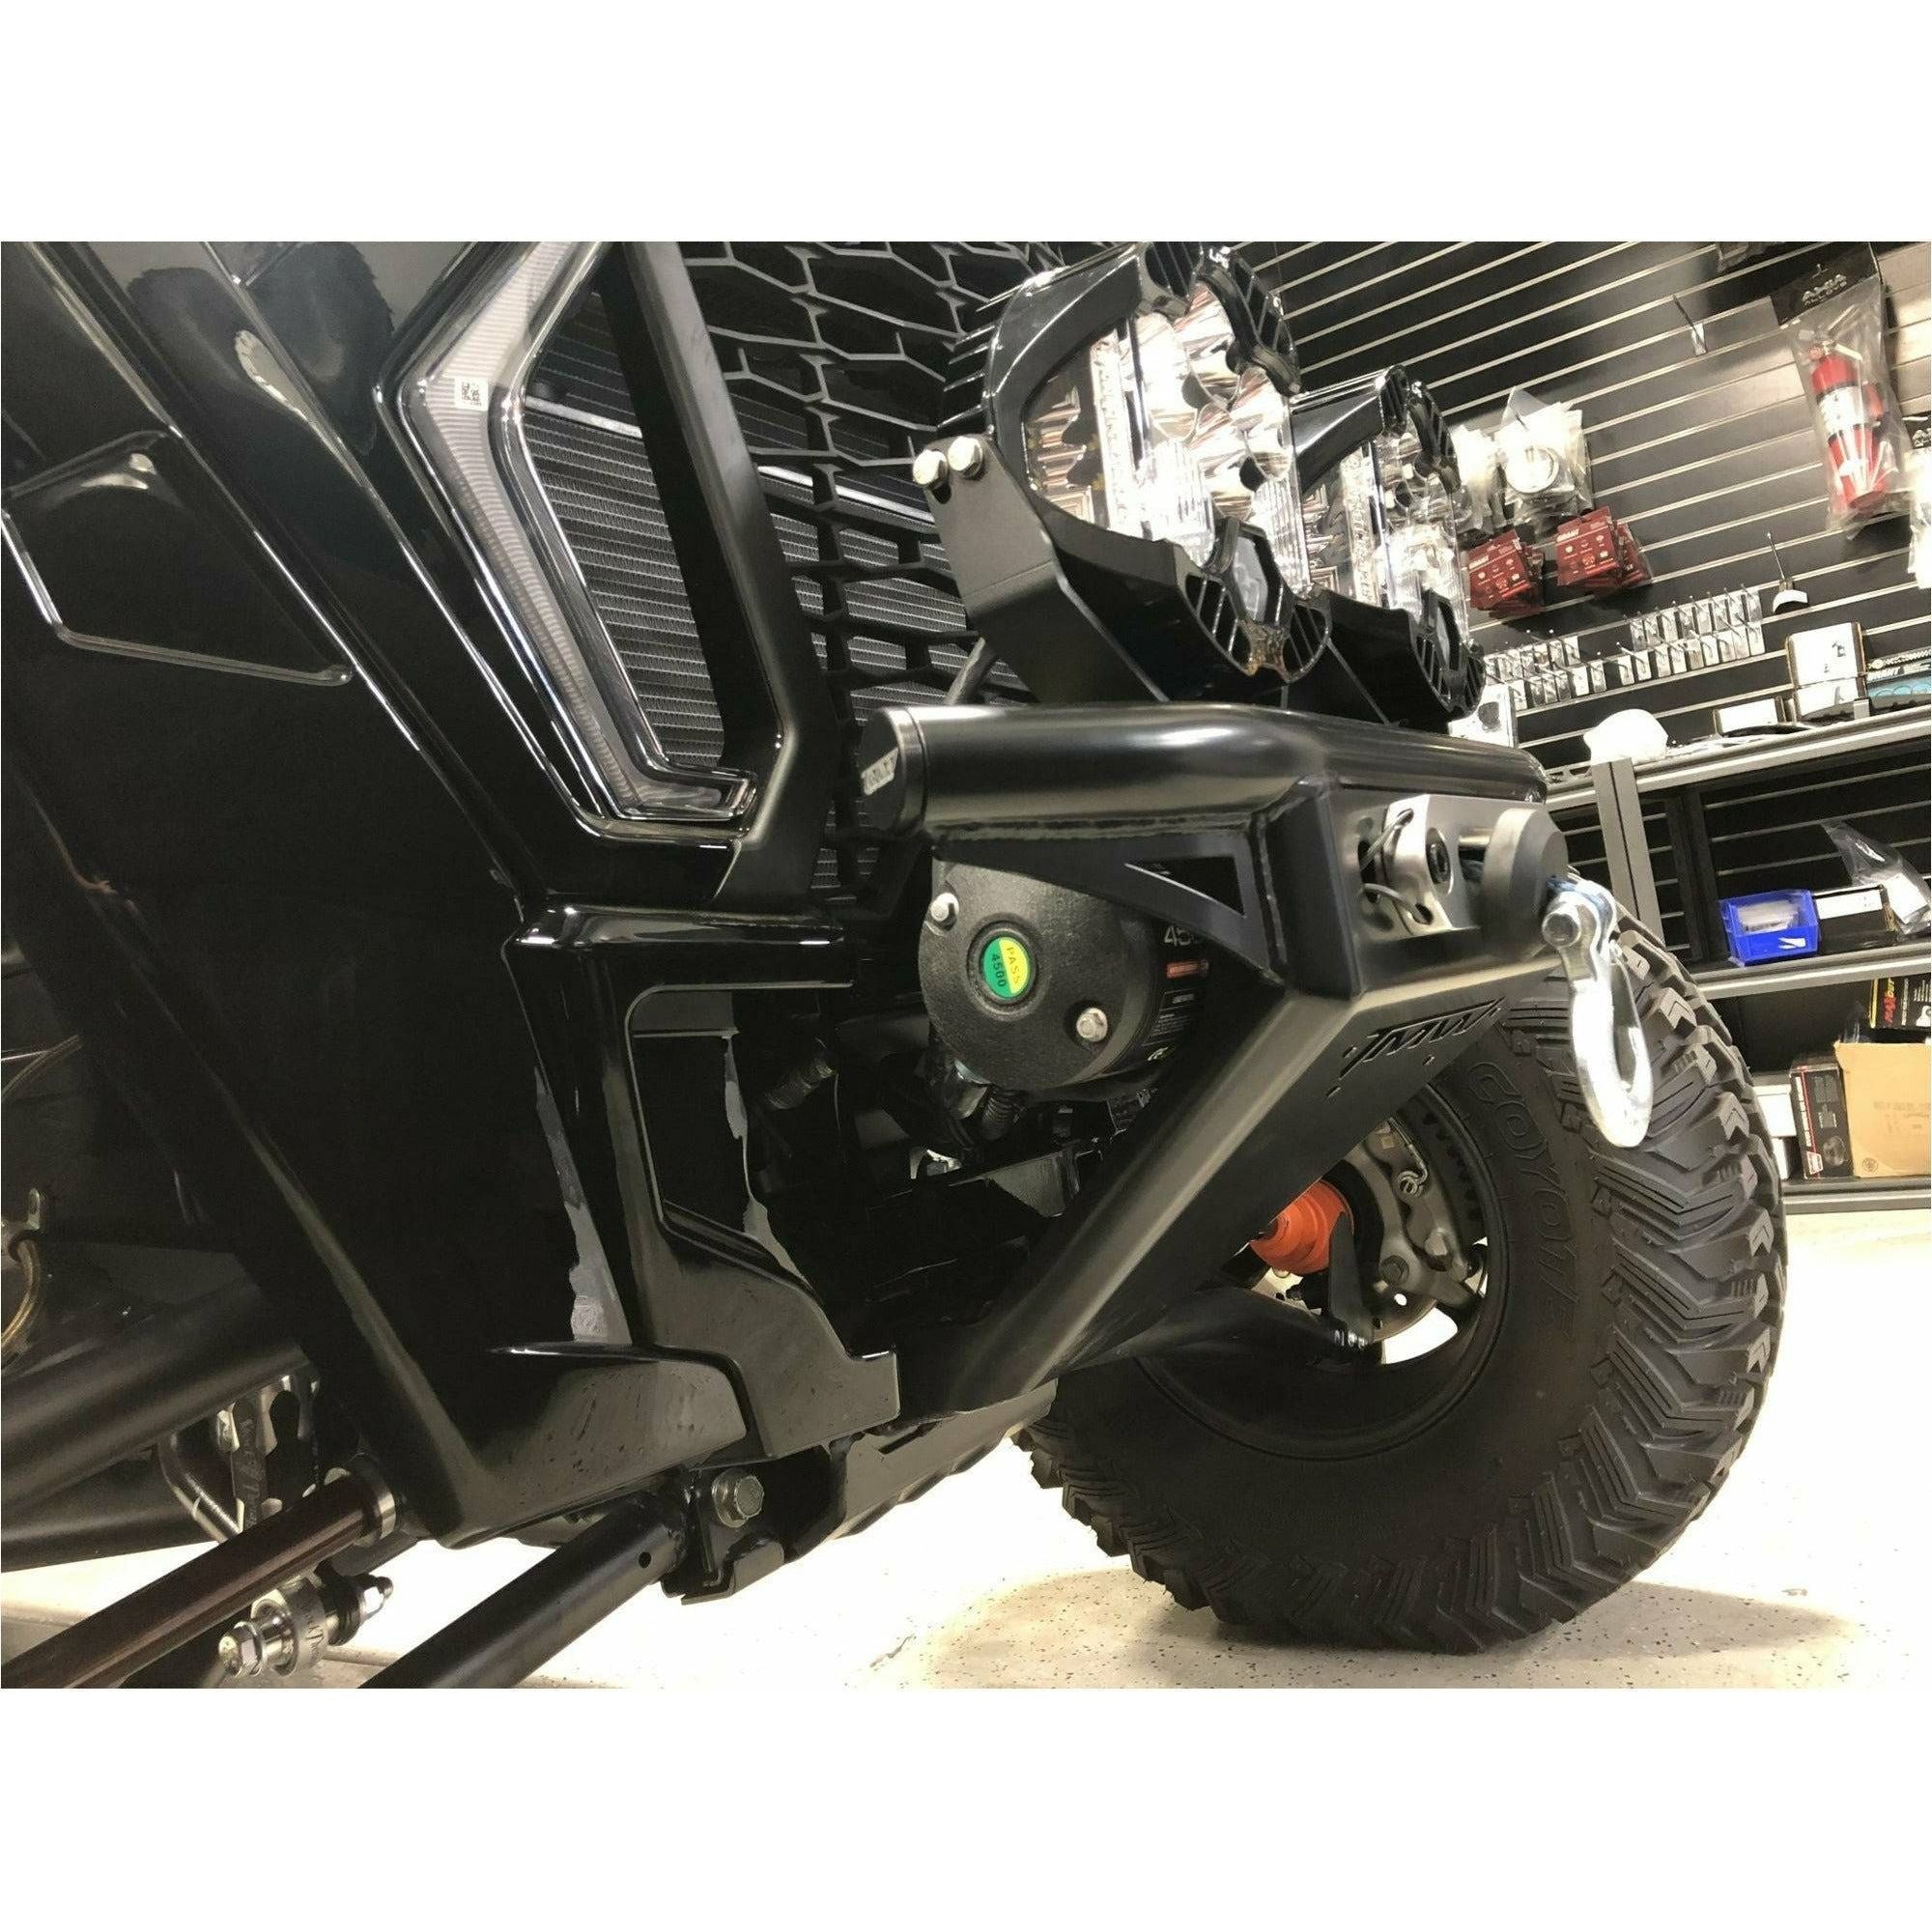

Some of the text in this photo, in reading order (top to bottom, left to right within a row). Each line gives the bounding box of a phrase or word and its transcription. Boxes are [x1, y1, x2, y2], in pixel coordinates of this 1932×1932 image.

[991, 953, 1007, 987] 4500
[1006, 947, 1021, 983] PASS
[1466, 1061, 1581, 1343] COYOTE
